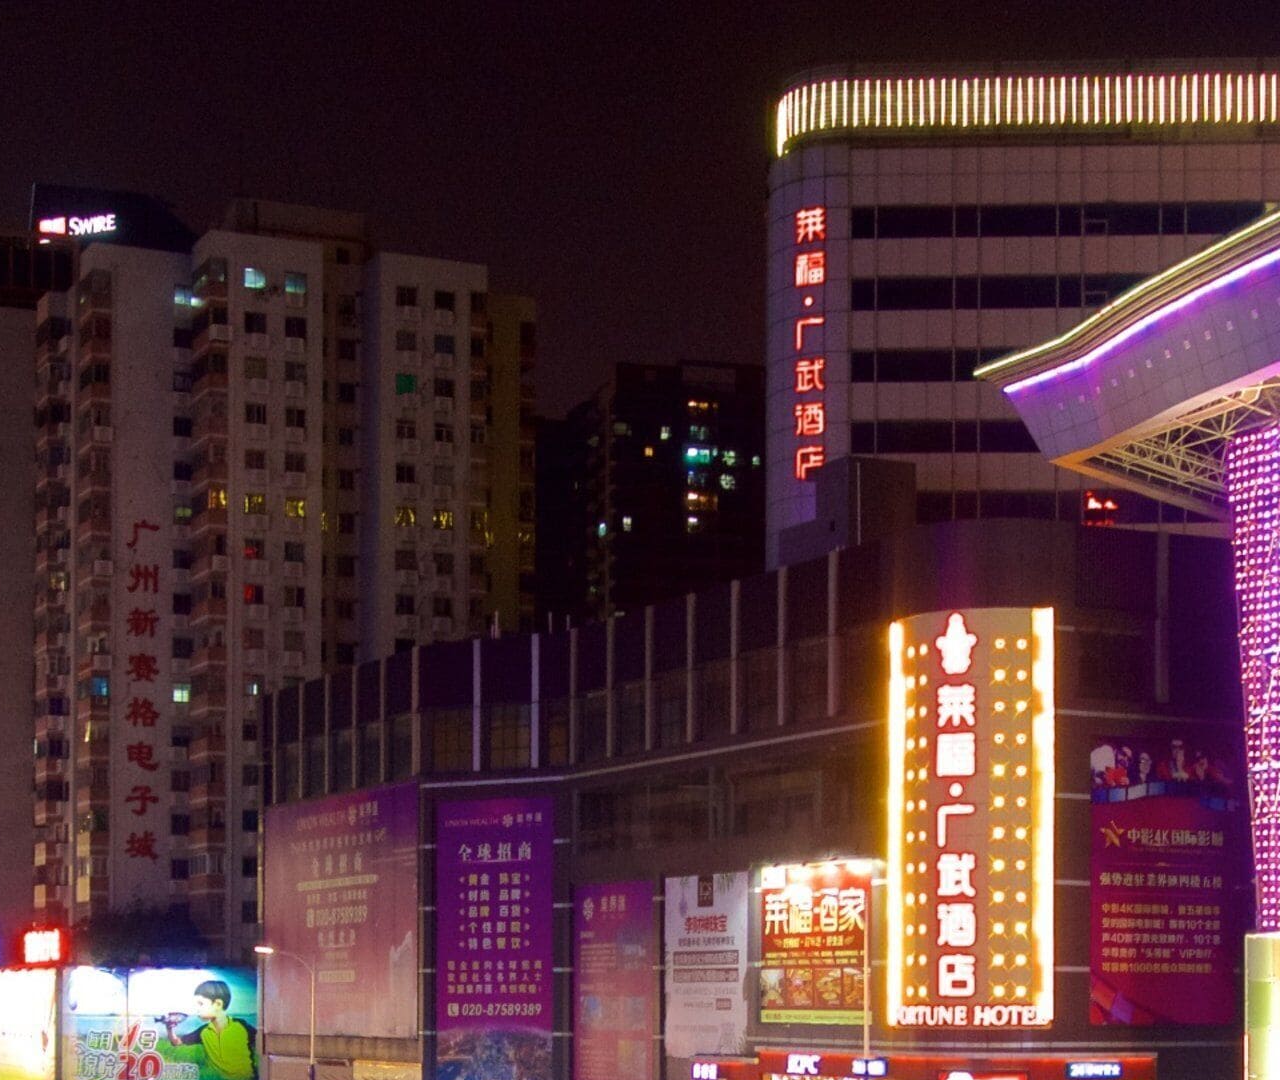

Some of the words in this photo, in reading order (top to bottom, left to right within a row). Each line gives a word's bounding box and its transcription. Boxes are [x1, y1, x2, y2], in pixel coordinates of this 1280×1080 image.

[69, 214, 117, 236] SWIRE
[126, 519, 160, 865] 广州新赛格电子城
[459, 841, 532, 861] 全球招商
